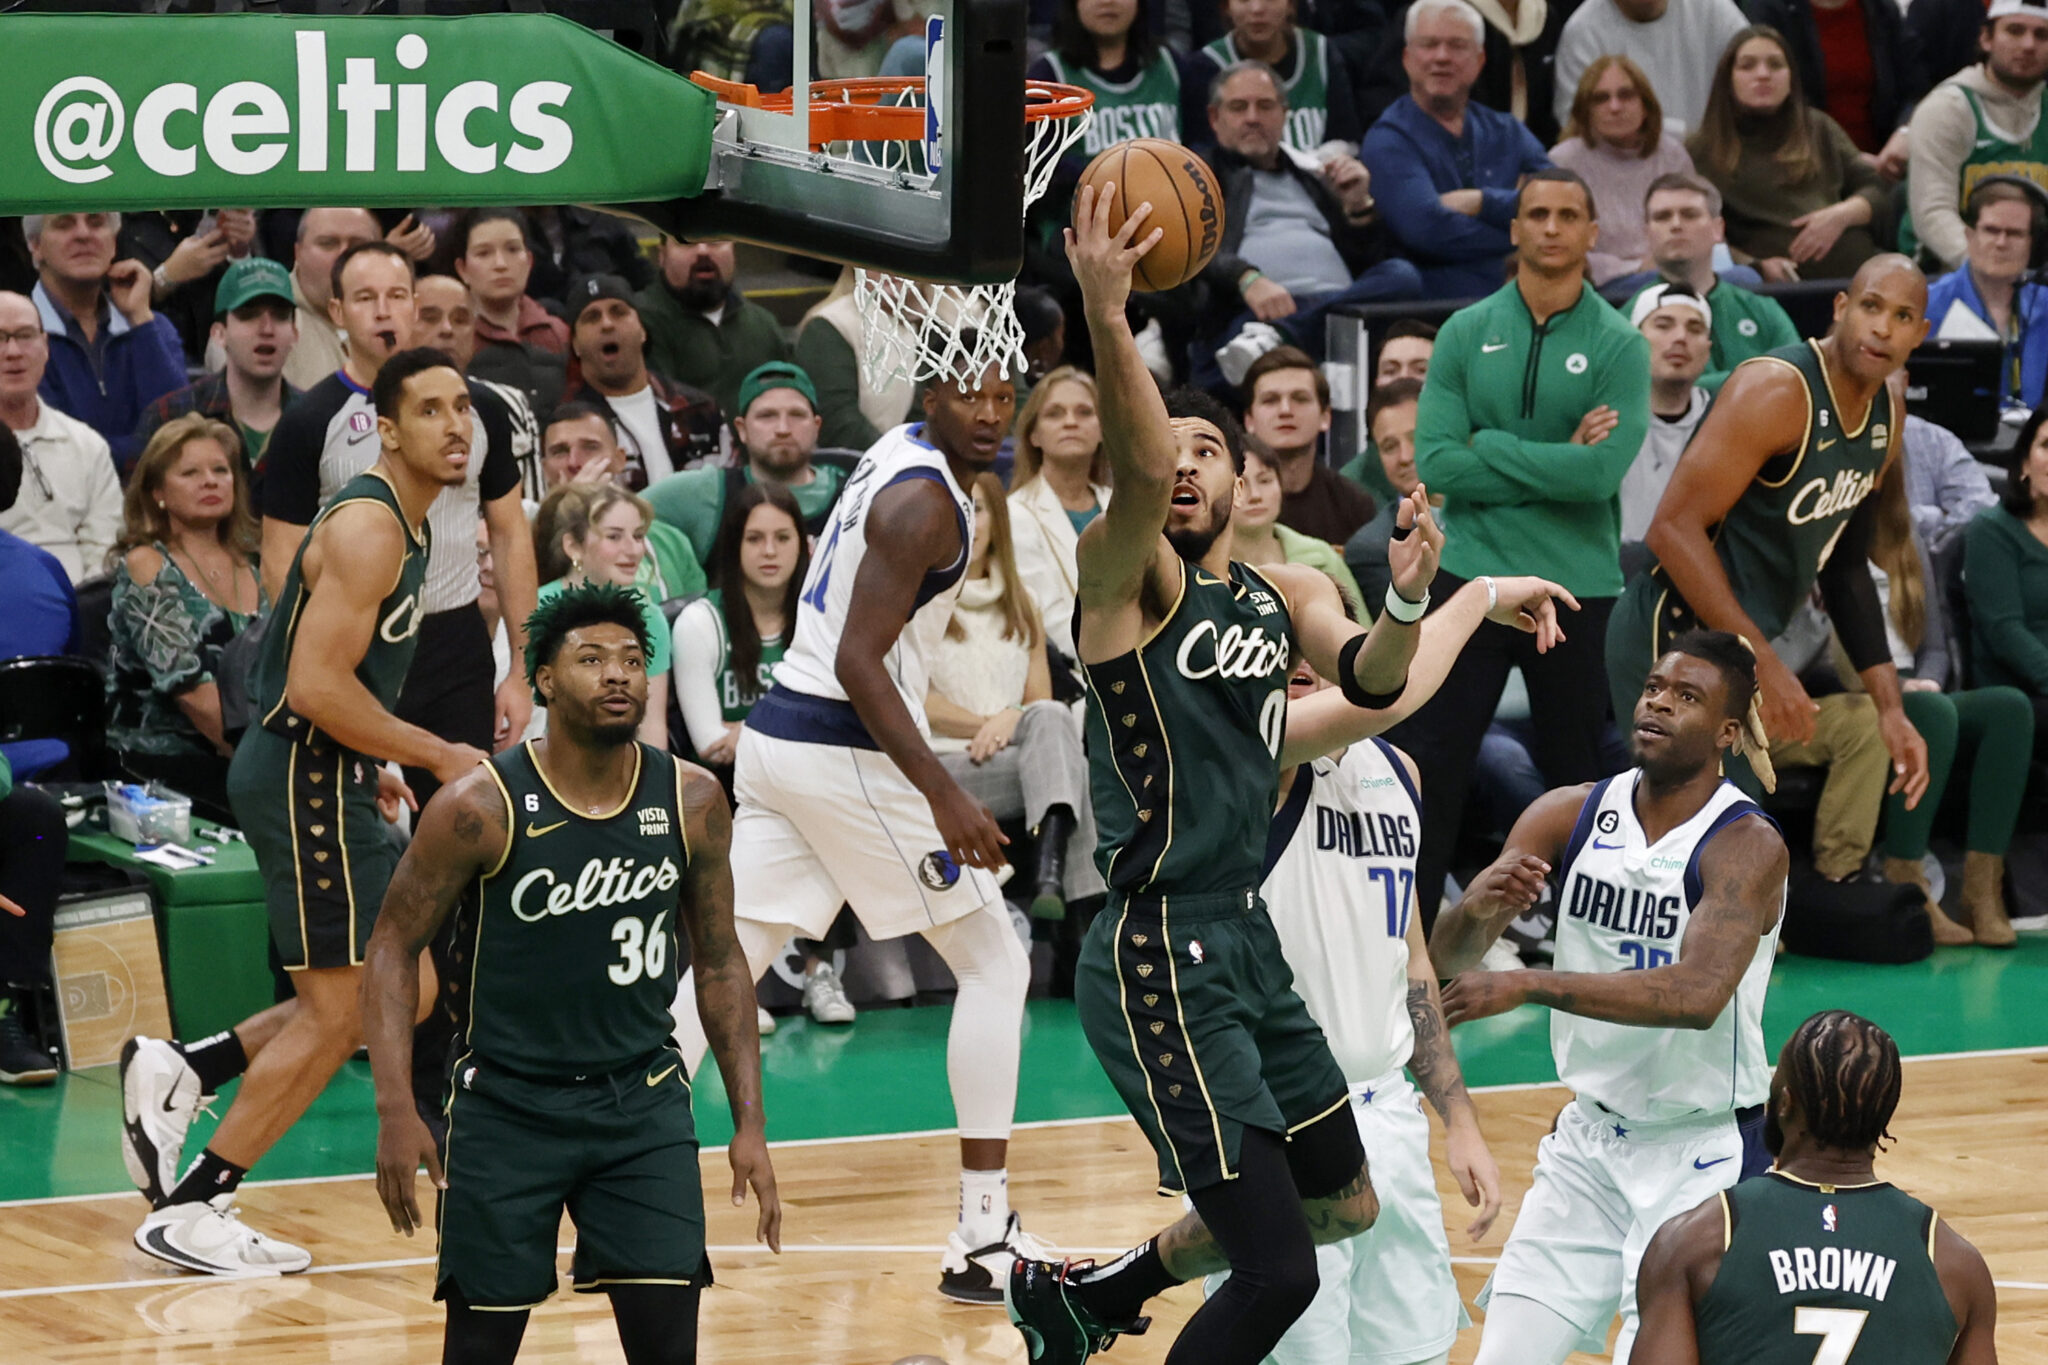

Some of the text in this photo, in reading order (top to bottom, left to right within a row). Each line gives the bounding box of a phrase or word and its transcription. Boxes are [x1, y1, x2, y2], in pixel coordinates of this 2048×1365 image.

[33, 30, 574, 184] @celtics
[1282, 106, 1328, 150] TON
[1249, 591, 1274, 604] STA
[1176, 619, 1290, 680] Cltcs
[525, 793, 539, 812] 6
[1360, 776, 1395, 789] chime
[637, 807, 669, 824] VISTA
[639, 822, 670, 836] PRINT
[1316, 805, 1416, 859] DALLAS
[1600, 812, 1616, 833] 6
[511, 856, 679, 922] Celtics
[1650, 856, 1685, 870] chim
[1367, 867, 1414, 939] 77
[1569, 873, 1681, 940] DALLAS
[608, 909, 669, 986] 36
[1768, 1247, 1898, 1302] BROWN
[1794, 1306, 1870, 1365] 7
